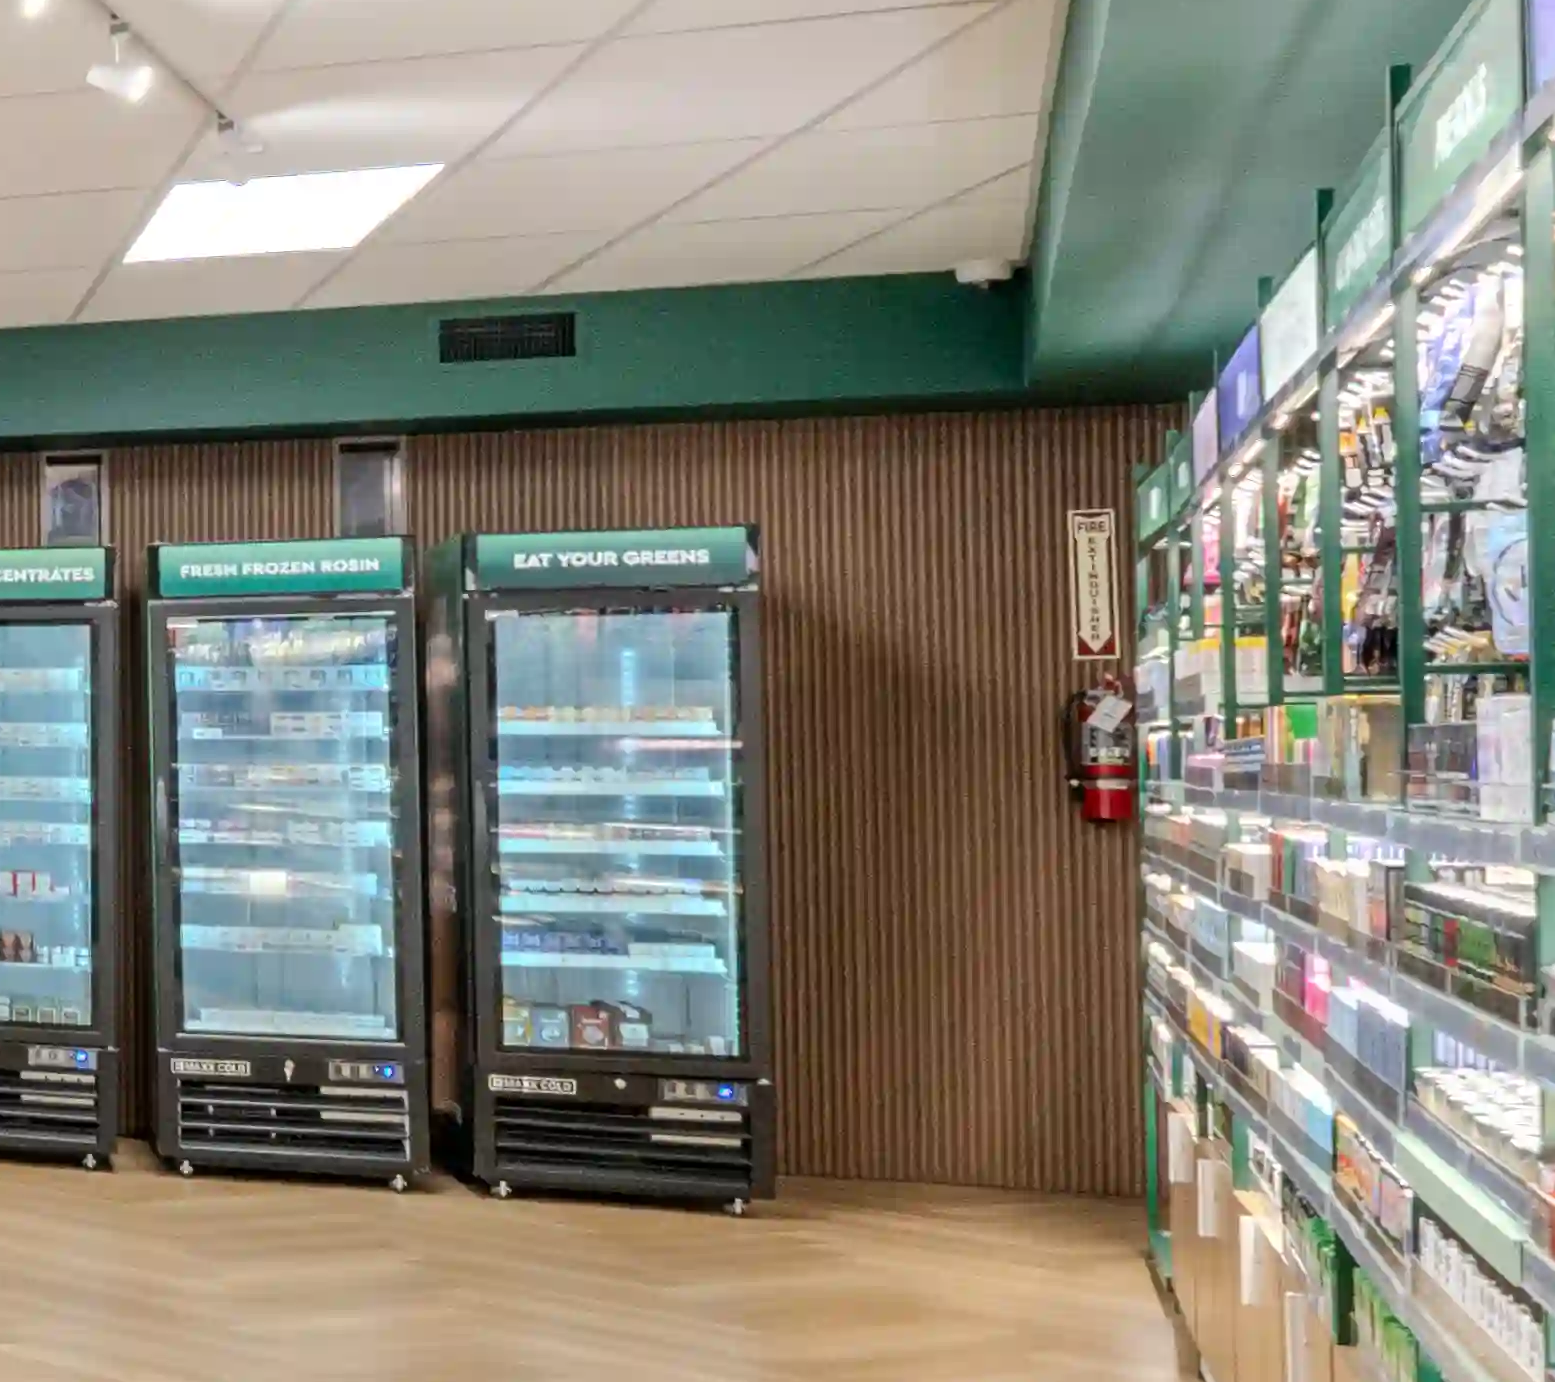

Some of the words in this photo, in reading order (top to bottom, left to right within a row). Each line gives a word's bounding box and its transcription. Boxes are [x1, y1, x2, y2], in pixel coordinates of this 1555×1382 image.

[1077, 520, 1107, 533] FIRE
[179, 564, 238, 579] FRESH
[241, 560, 315, 576] FROZEN
[320, 557, 380, 572] ROSIN
[513, 552, 552, 570] EAT
[556, 549, 619, 568] YOUR
[622, 548, 710, 566] GREENS
